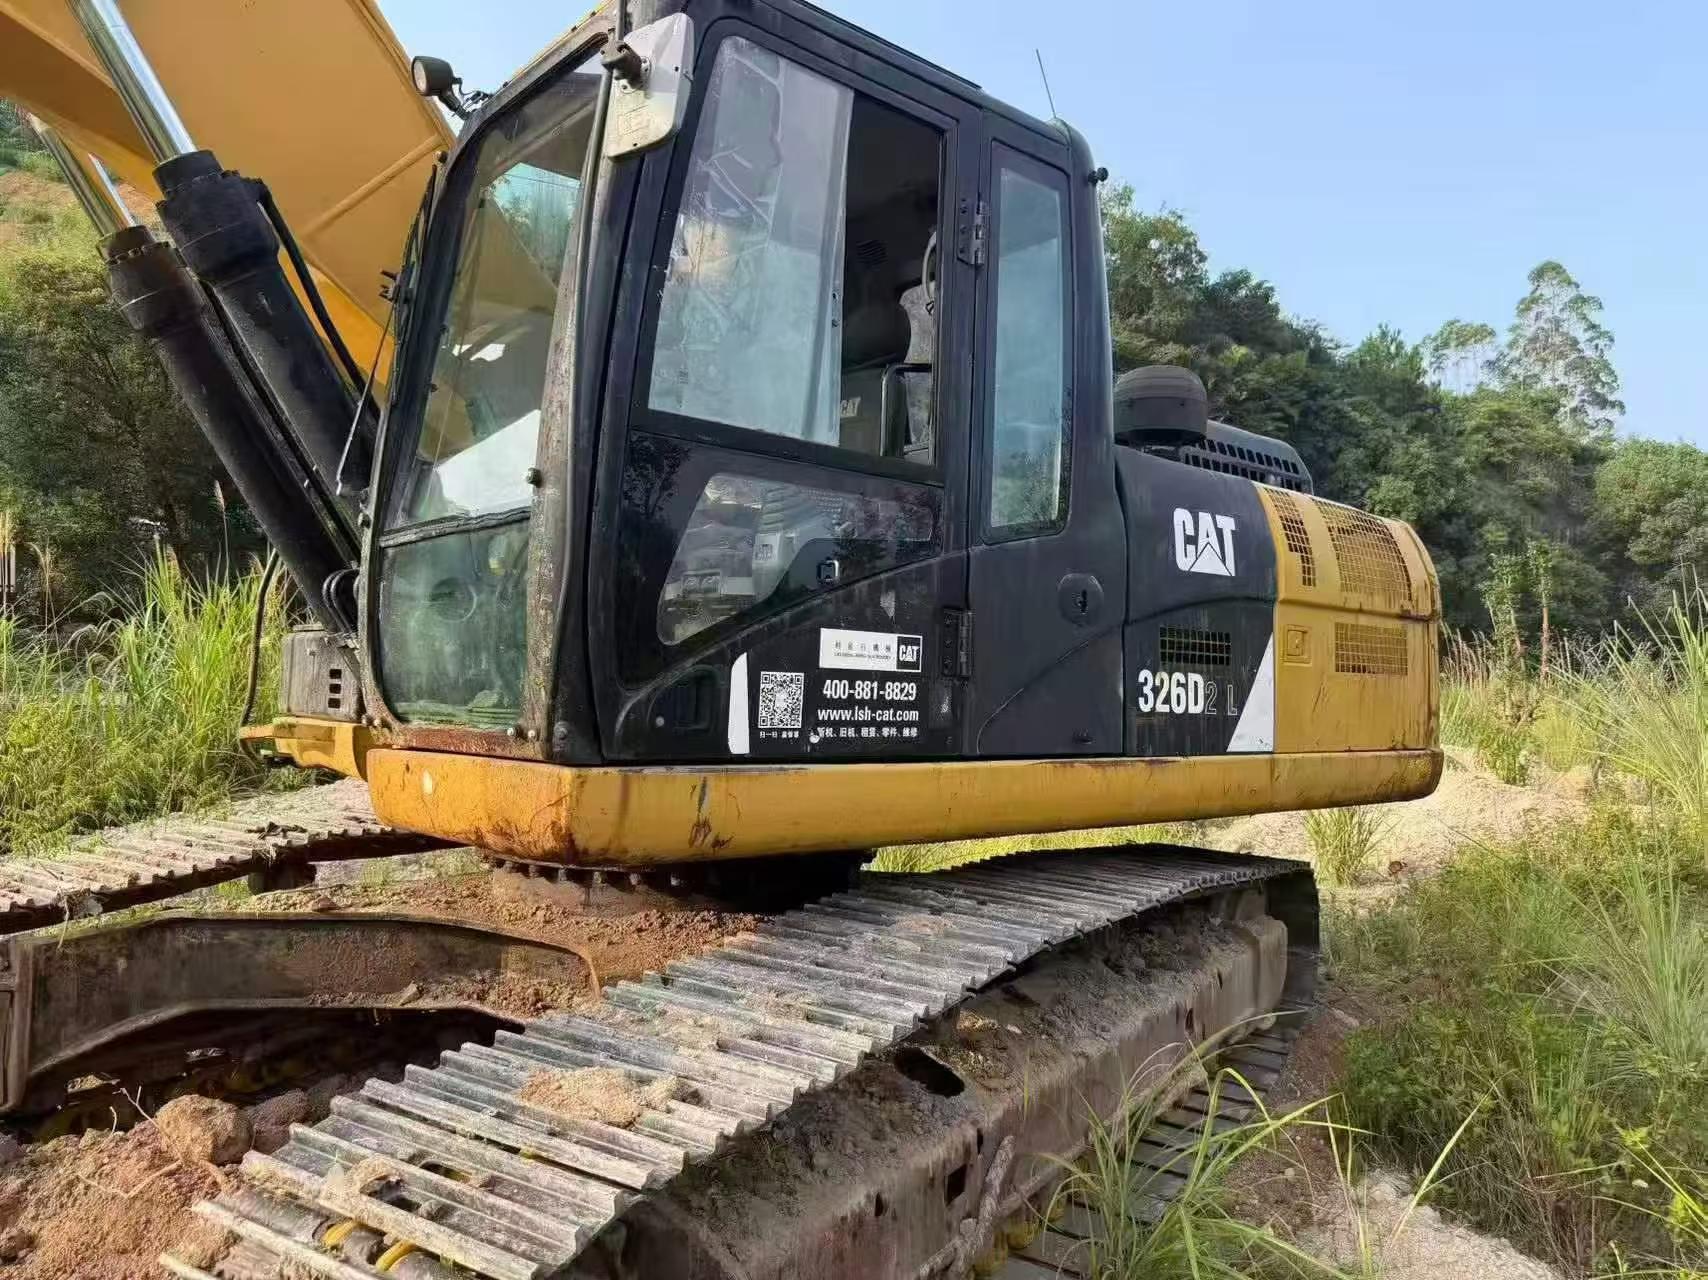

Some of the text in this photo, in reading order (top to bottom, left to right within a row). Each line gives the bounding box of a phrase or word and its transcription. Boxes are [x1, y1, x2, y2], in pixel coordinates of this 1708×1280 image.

[840, 396, 861, 417] CAT
[1173, 508, 1237, 576] CAT
[899, 645, 919, 661] CAT
[823, 680, 917, 701] 400-881-8829
[1227, 684, 1238, 716] L
[818, 706, 919, 721] www.lsh-cat.com
